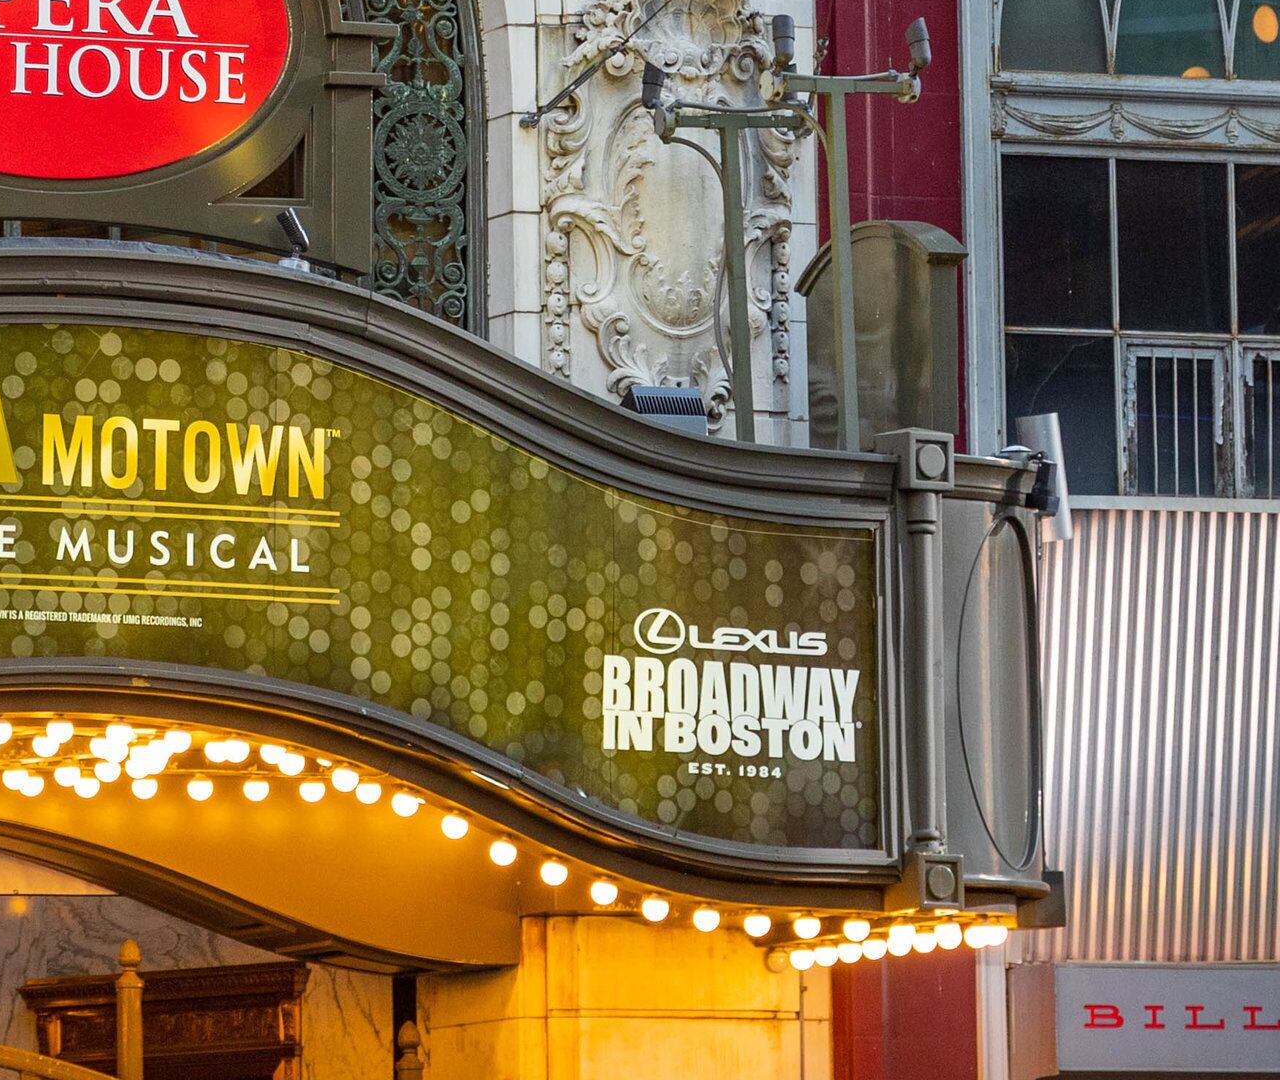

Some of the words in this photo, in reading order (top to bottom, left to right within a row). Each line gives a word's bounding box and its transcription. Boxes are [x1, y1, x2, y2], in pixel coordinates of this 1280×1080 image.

[10, 41, 246, 105] HOUSE
[57, 526, 310, 573] MUSICAL
[9, 610, 17, 620] IS
[18, 610, 24, 620] A
[25, 610, 67, 622] REGISTERED
[69, 612, 112, 623] TRADEMARK
[113, 614, 122, 624] OF
[123, 614, 140, 625] UMG
[189, 617, 203, 628] INC
[688, 624, 828, 656] LEXUS
[602, 654, 860, 723] BROADWAY
[603, 709, 653, 751] IN
[664, 712, 856, 763] BOSTON
[688, 762, 731, 776] EST.
[738, 764, 782, 779] 1984
